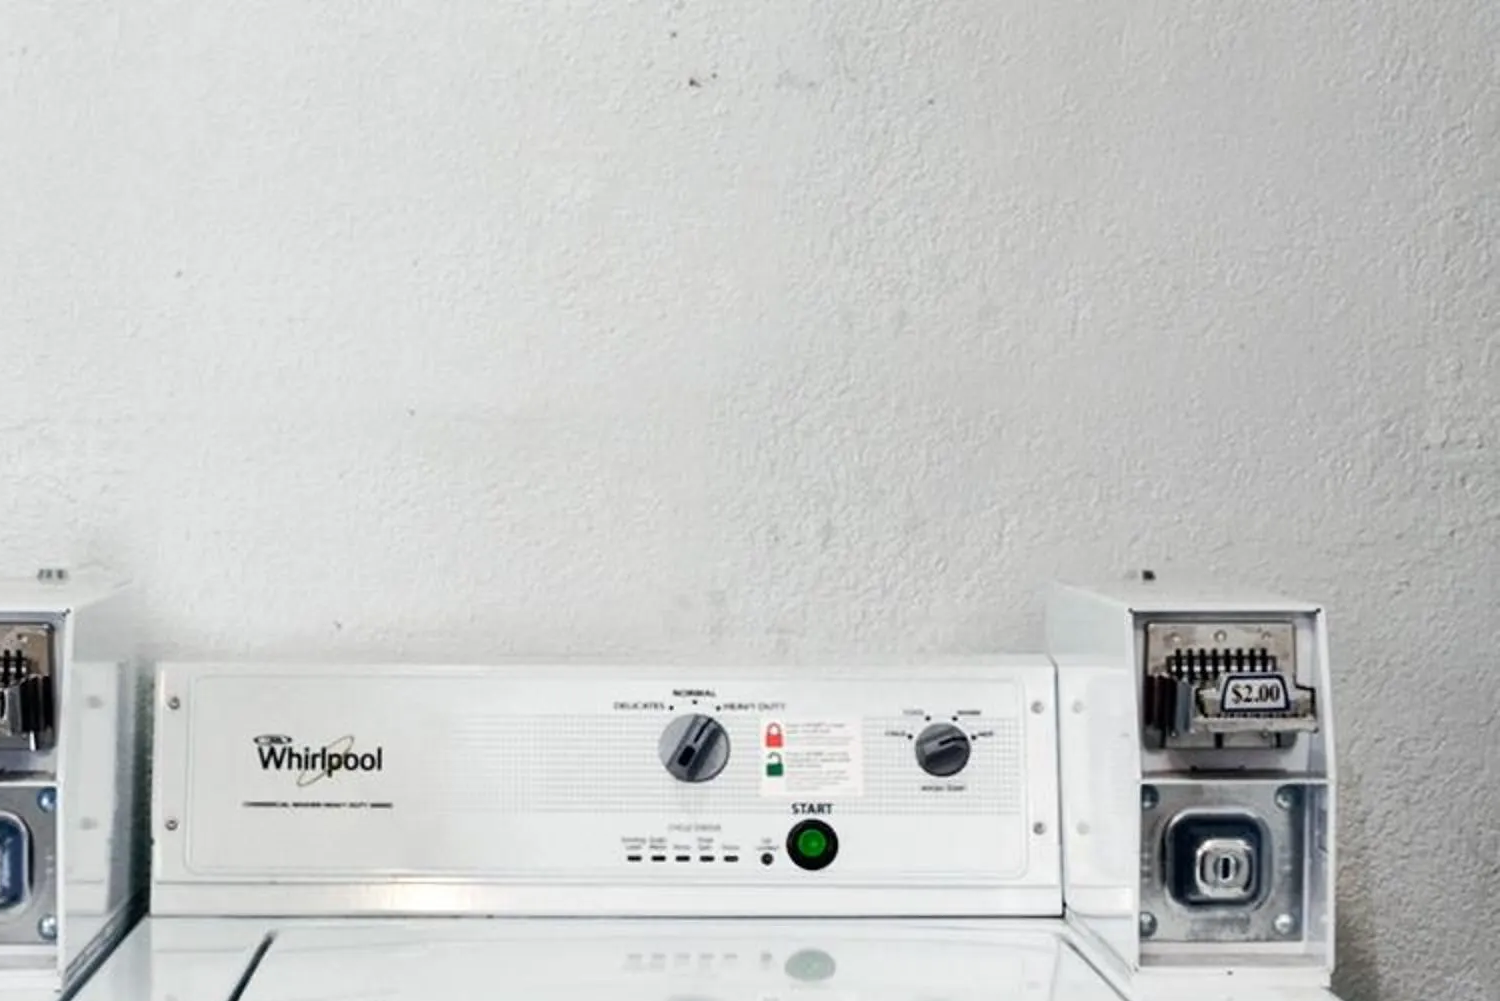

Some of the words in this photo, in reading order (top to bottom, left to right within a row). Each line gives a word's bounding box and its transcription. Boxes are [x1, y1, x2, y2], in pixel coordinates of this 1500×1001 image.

[1232, 684, 1280, 704] $2.00
[257, 745, 382, 778] Whirlpool
[791, 802, 835, 815] START
